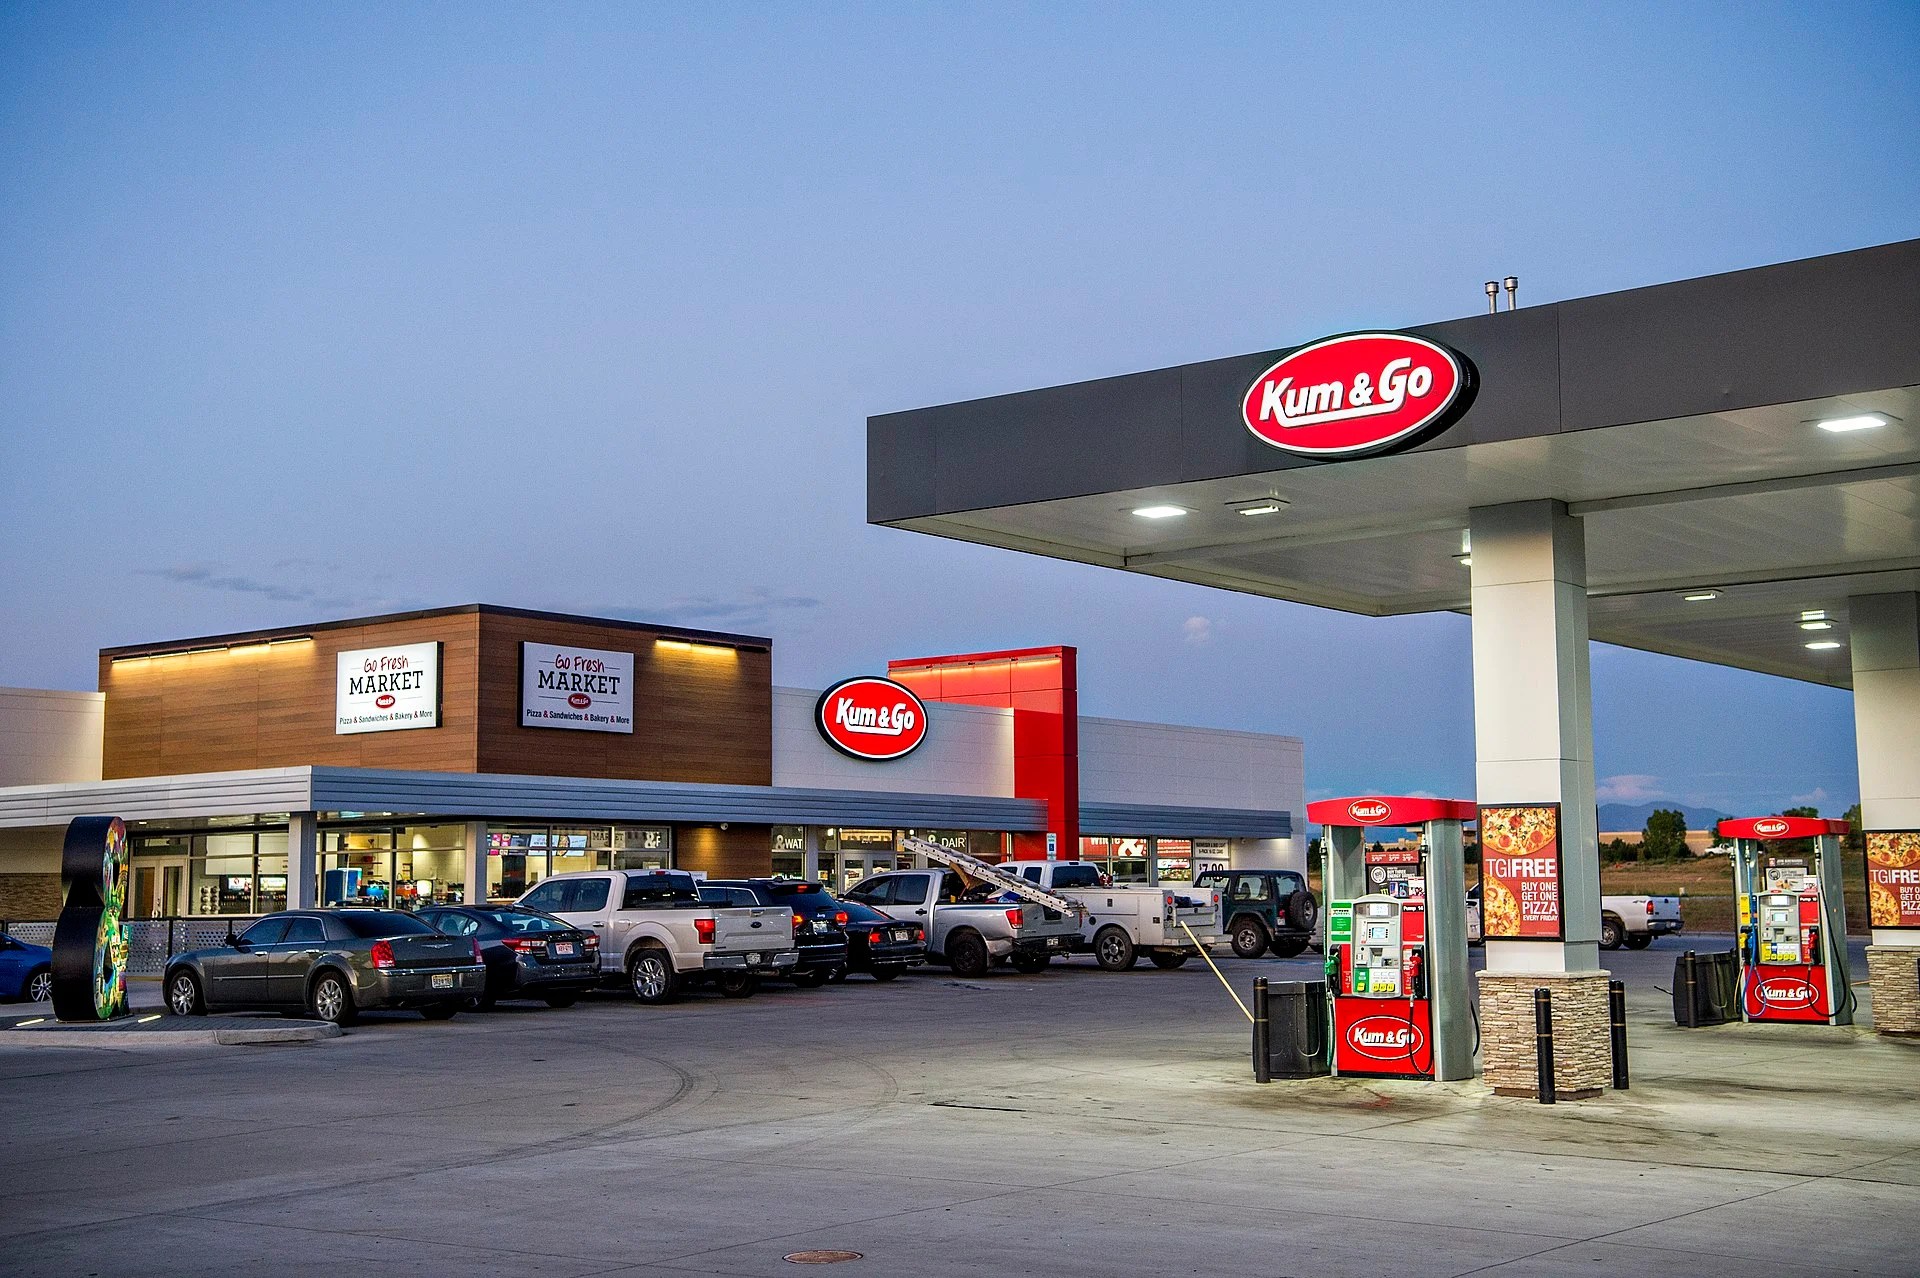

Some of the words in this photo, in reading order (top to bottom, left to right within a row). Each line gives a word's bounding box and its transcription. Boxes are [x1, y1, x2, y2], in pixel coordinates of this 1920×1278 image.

[1259, 377, 1344, 425] Kum
[1349, 372, 1374, 406] &
[1378, 357, 1432, 411] Go
[363, 658, 378, 673] Go
[380, 656, 409, 671] Fresh
[555, 654, 571, 670] Go
[574, 656, 605, 673] Fresh
[349, 670, 423, 695] MARKET
[538, 670, 620, 695] MARKET
[339, 717, 352, 725] Pizza
[359, 714, 388, 723] Sandwiches
[389, 713, 394, 721] &
[395, 712, 413, 721] Bakery
[414, 711, 418, 719] &
[419, 710, 433, 718] More
[526, 708, 542, 718] Pizza
[543, 710, 548, 718] &
[549, 711, 583, 721] Sandwiches
[584, 713, 589, 721] &
[590, 713, 609, 724] Bakery
[610, 715, 615, 723] &
[616, 716, 630, 724] More
[836, 697, 877, 729] Kum
[878, 706, 890, 728] &
[891, 703, 915, 734] Go
[592, 832, 624, 841] MARET
[941, 837, 966, 848] DAIR
[1485, 858, 1557, 878] TGIFREE
[1870, 869, 1920, 884] TGIFRE
[1521, 881, 1538, 891] BUY
[1540, 882, 1557, 891] ONE
[1900, 886, 1913, 894] BUY
[1521, 891, 1538, 901] GET
[1540, 892, 1558, 901] ONE
[1522, 901, 1558, 915] PIZZA
[1787, 988, 1795, 998] &
[1353, 1027, 1385, 1045] Kum
[1386, 1031, 1395, 1043] &
[1396, 1028, 1415, 1047] Go
